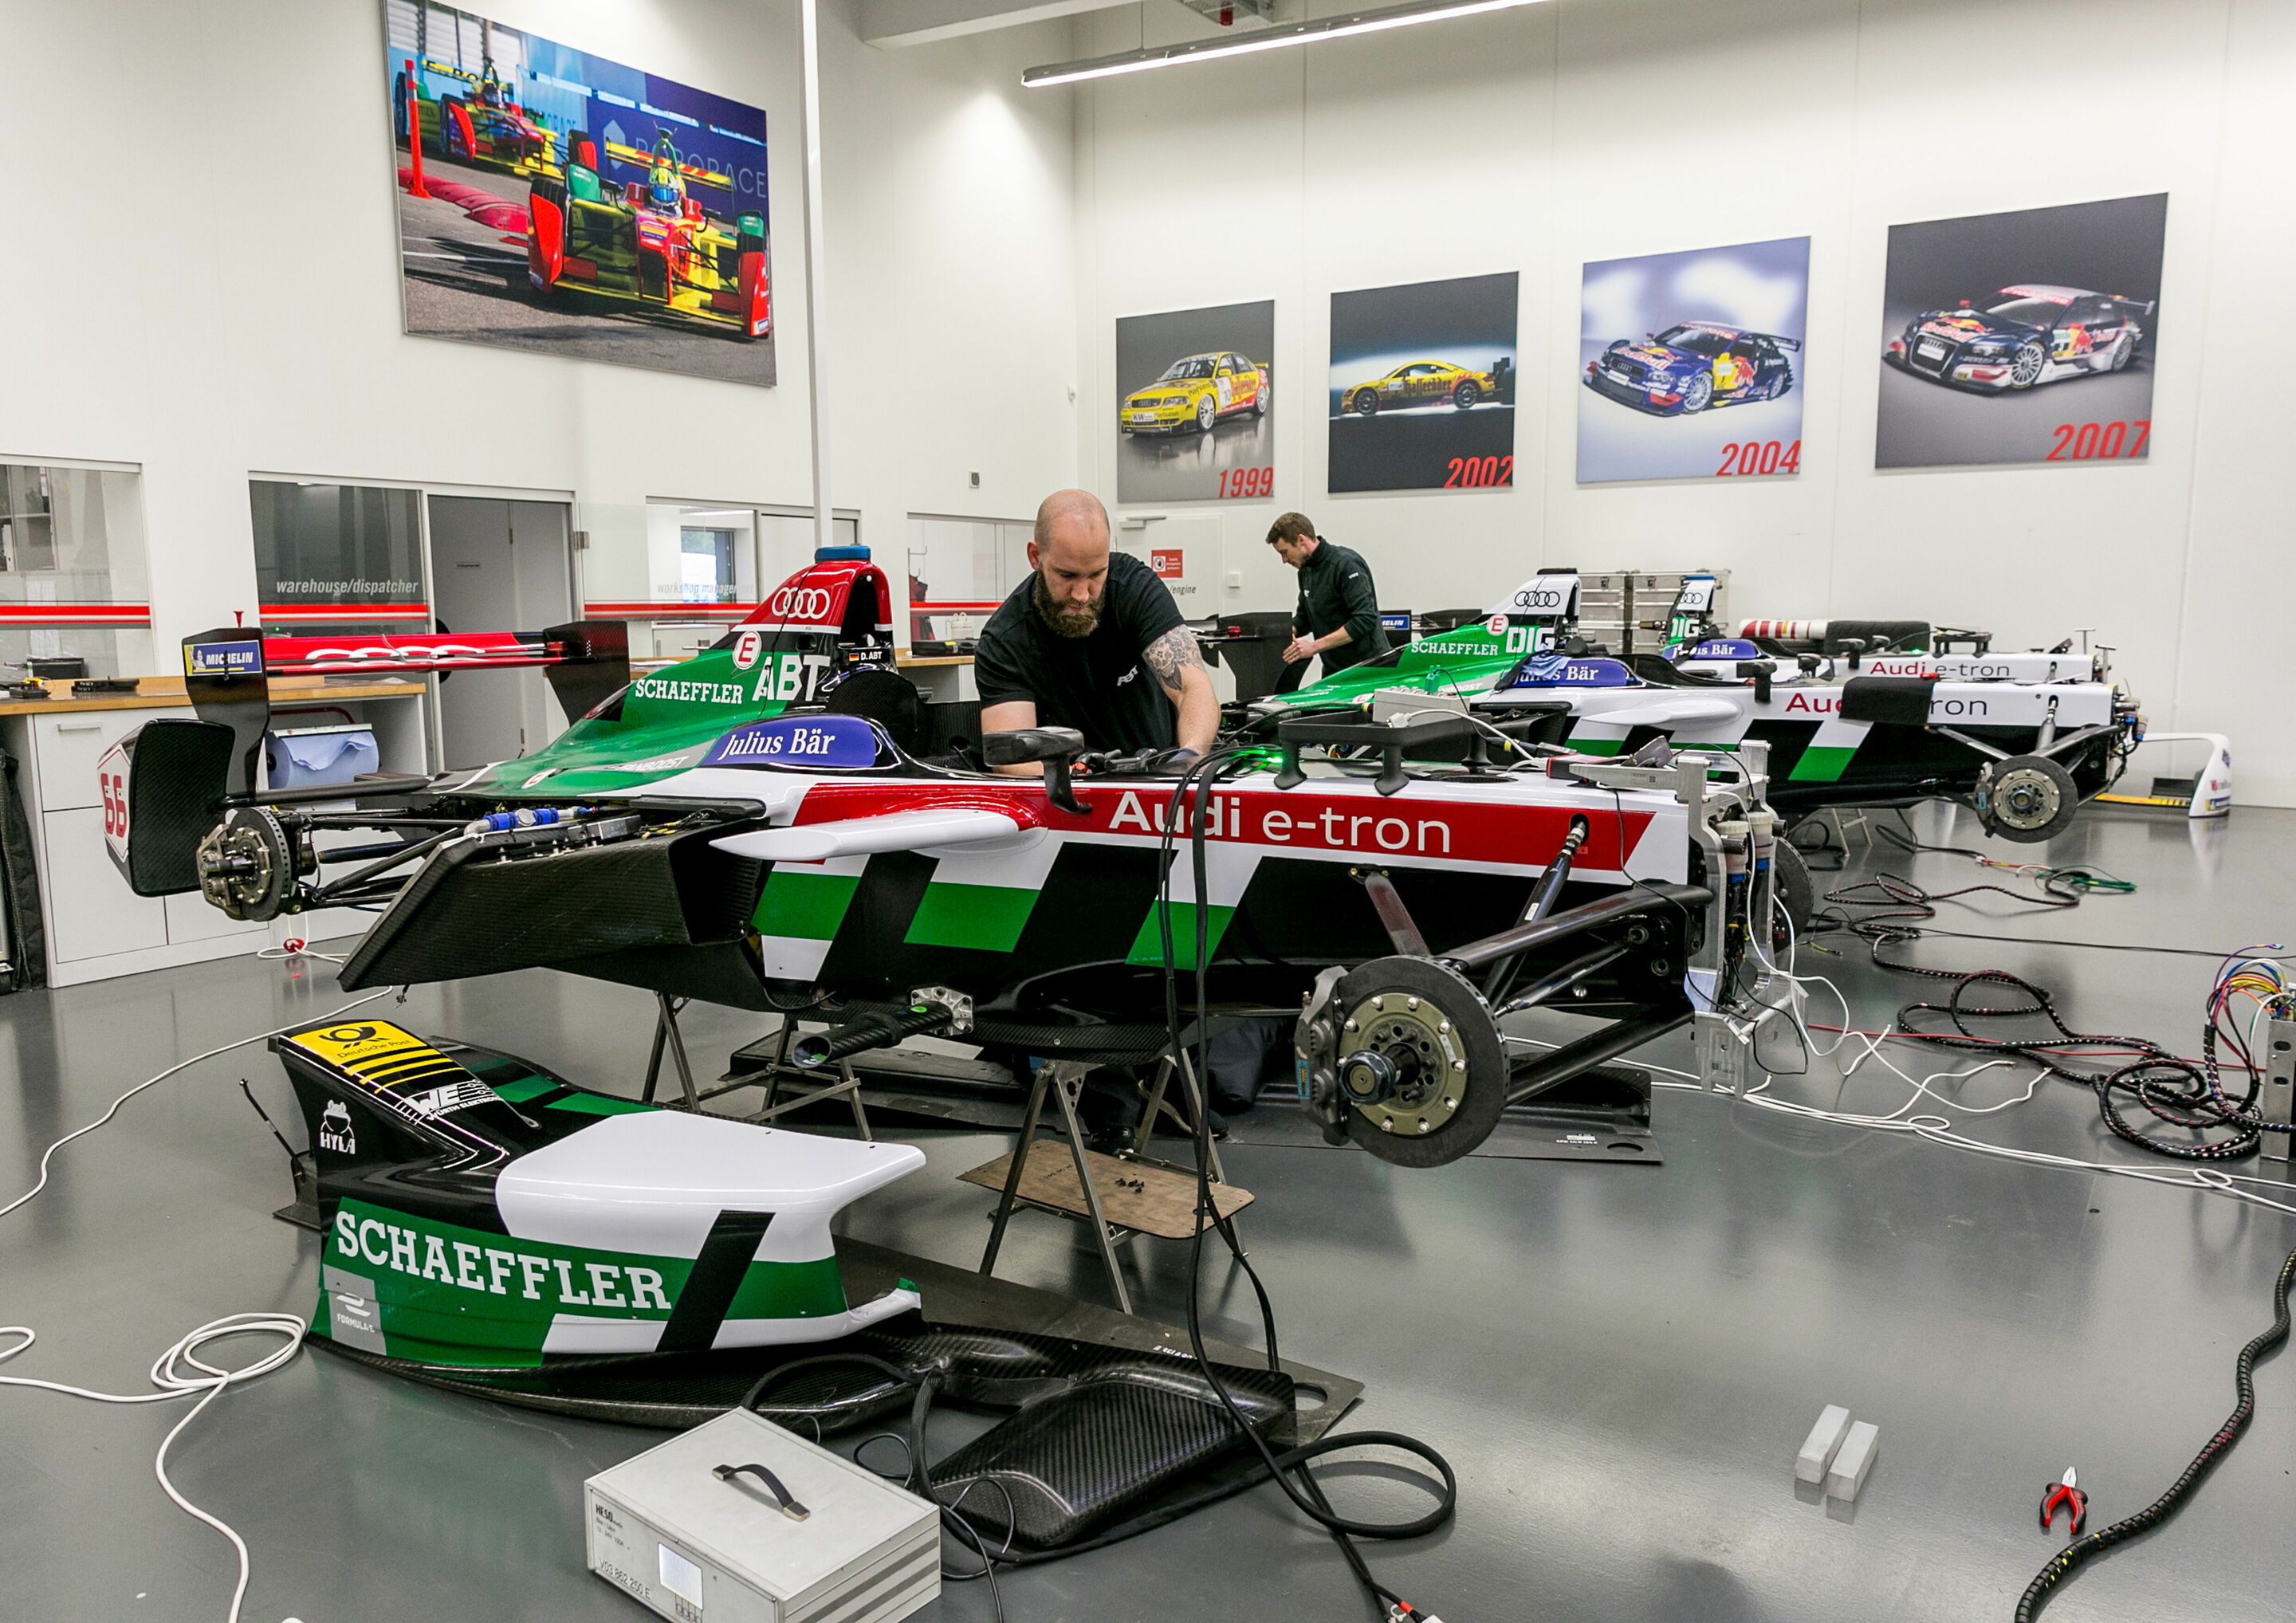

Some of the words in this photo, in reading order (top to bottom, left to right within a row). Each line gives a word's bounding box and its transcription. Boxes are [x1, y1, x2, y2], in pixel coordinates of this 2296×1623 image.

[2046, 420, 2151, 462] 2007
[1444, 455, 1513, 489] 2002
[1716, 439, 1802, 477] 2004
[1218, 466, 1274, 499] 1999
[276, 578, 419, 596] warehouse/dispatcher
[1410, 642, 1499, 657] SCHAEFFLER
[1506, 627, 1555, 653] DIG
[1712, 644, 1736, 655] Bär
[752, 654, 831, 702] ABT
[1566, 666, 1599, 681] Bär
[1869, 662, 1925, 676] Audi
[1935, 665, 2010, 677] e-tron
[635, 678, 743, 705] SCHAEFFLER
[718, 729, 783, 760] Julius
[788, 728, 835, 756] Bär
[100, 772, 128, 839] 66
[1108, 790, 1240, 838] Audi
[1262, 806, 1450, 853] e-tron
[338, 1043, 390, 1059] Deutsche
[391, 1039, 412, 1049] Post
[320, 1131, 356, 1154] HYLA
[336, 1210, 672, 1311] SCHAEFFLER
